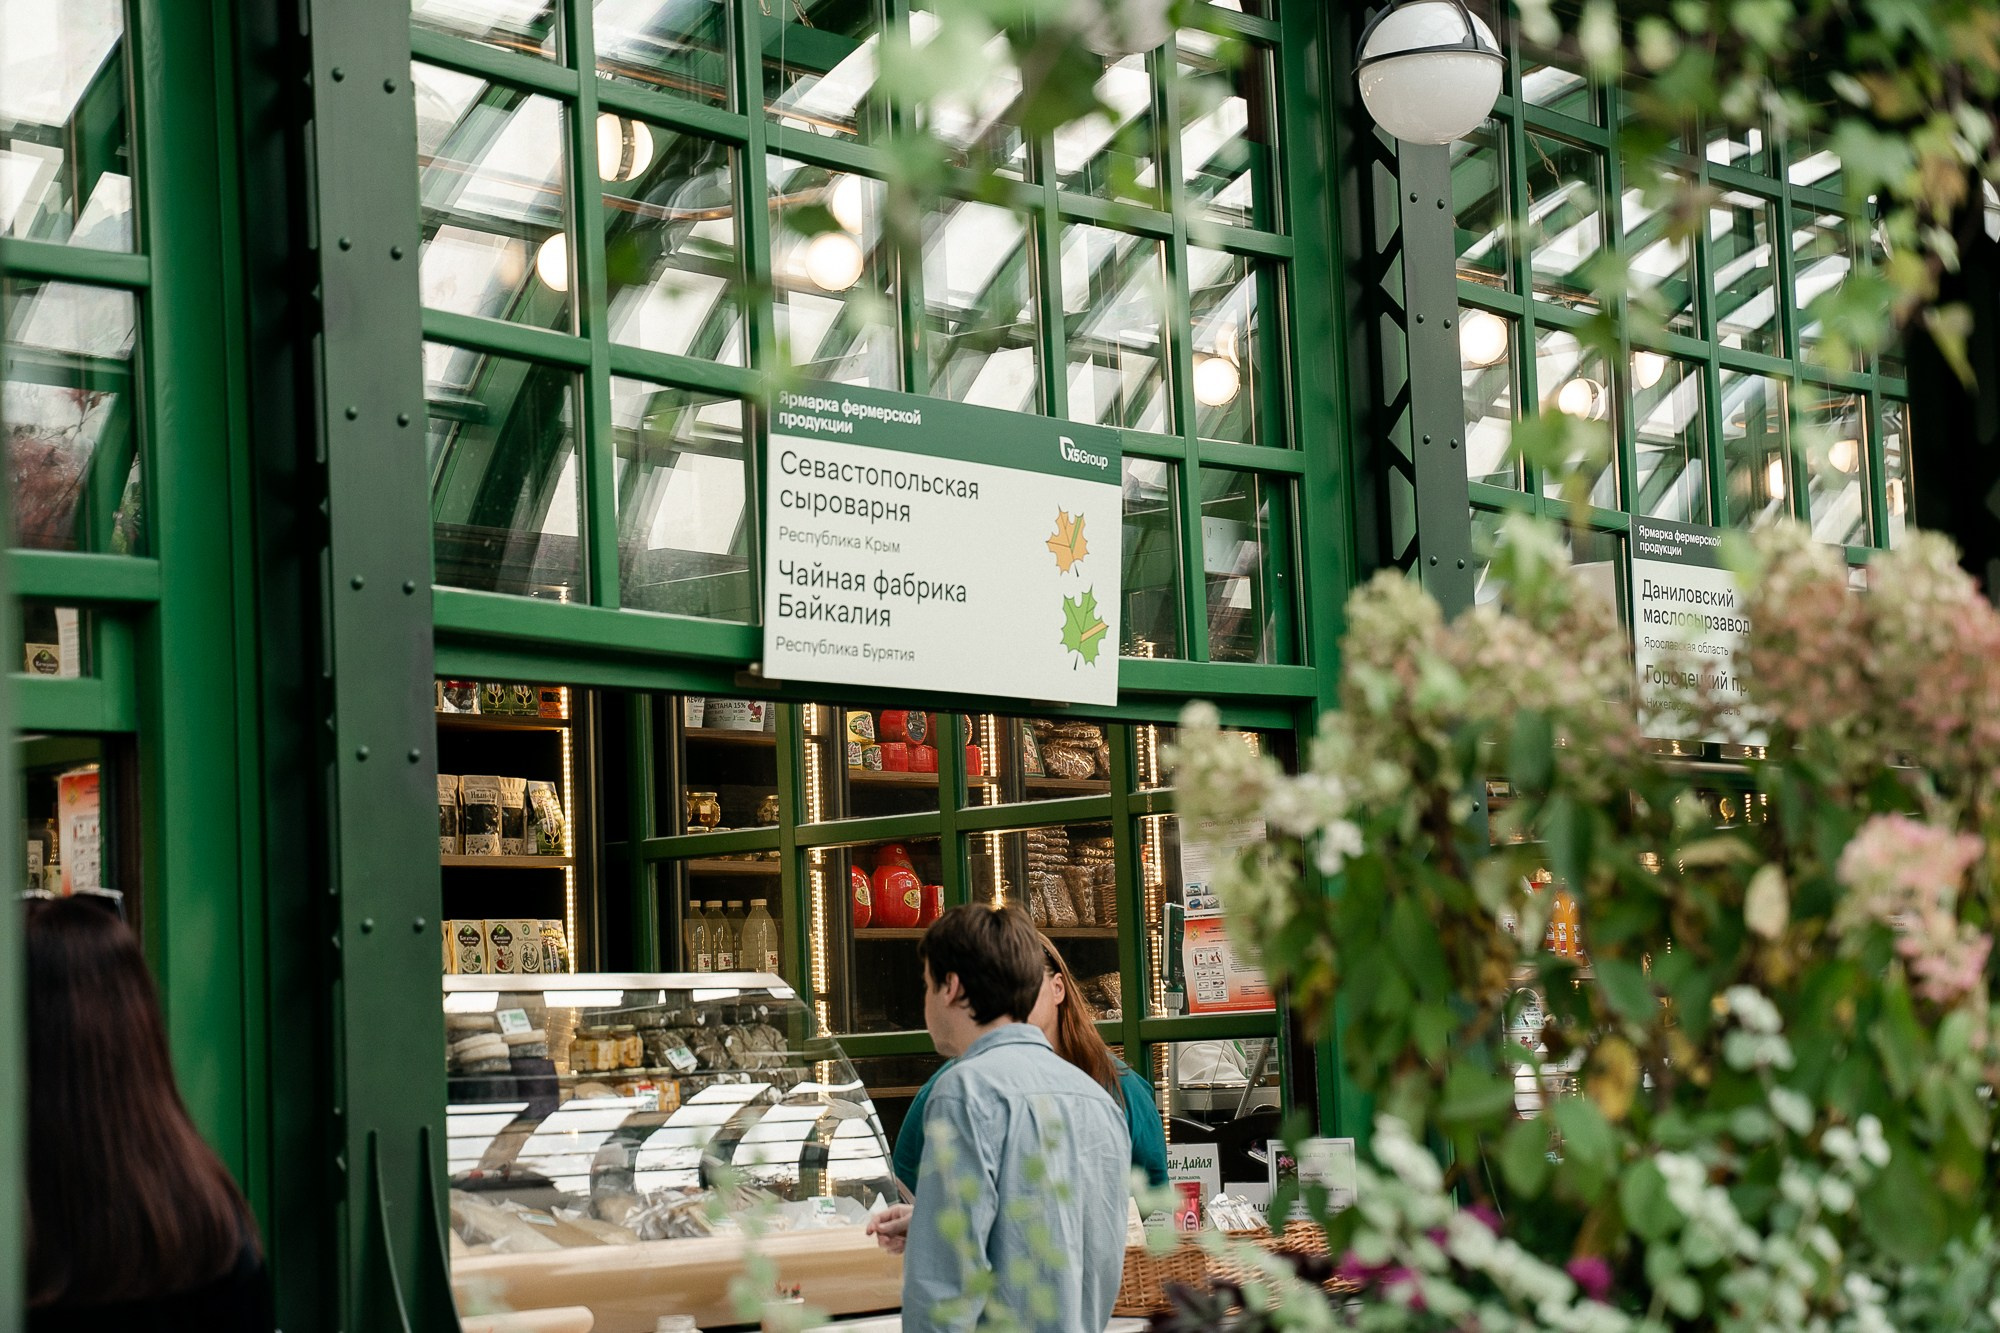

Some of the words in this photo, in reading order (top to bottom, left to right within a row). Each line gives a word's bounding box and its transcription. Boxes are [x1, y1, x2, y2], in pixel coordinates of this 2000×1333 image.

[779, 390, 839, 413] Ярмарка
[841, 398, 921, 425] фермерской
[779, 411, 853, 434] продукции
[780, 450, 979, 500] Севастопольская
[780, 489, 910, 525] сыроварня
[778, 525, 861, 548] Республика
[865, 536, 900, 554] Крым
[1638, 524, 1673, 541] Ярмарка
[1674, 531, 1722, 548] фермерской
[1639, 541, 1682, 556] продукции
[779, 559, 866, 592] Чайная
[873, 569, 967, 605] фабрика
[1642, 578, 1734, 608] Даниловский
[778, 592, 891, 627] Байкалия
[1643, 607, 1751, 636] маслосырзавод
[775, 635, 859, 658] Республика
[862, 643, 915, 662] Бурятия
[1698, 642, 1729, 656] область
[1167, 1156, 1213, 1172] ан-Дайля
